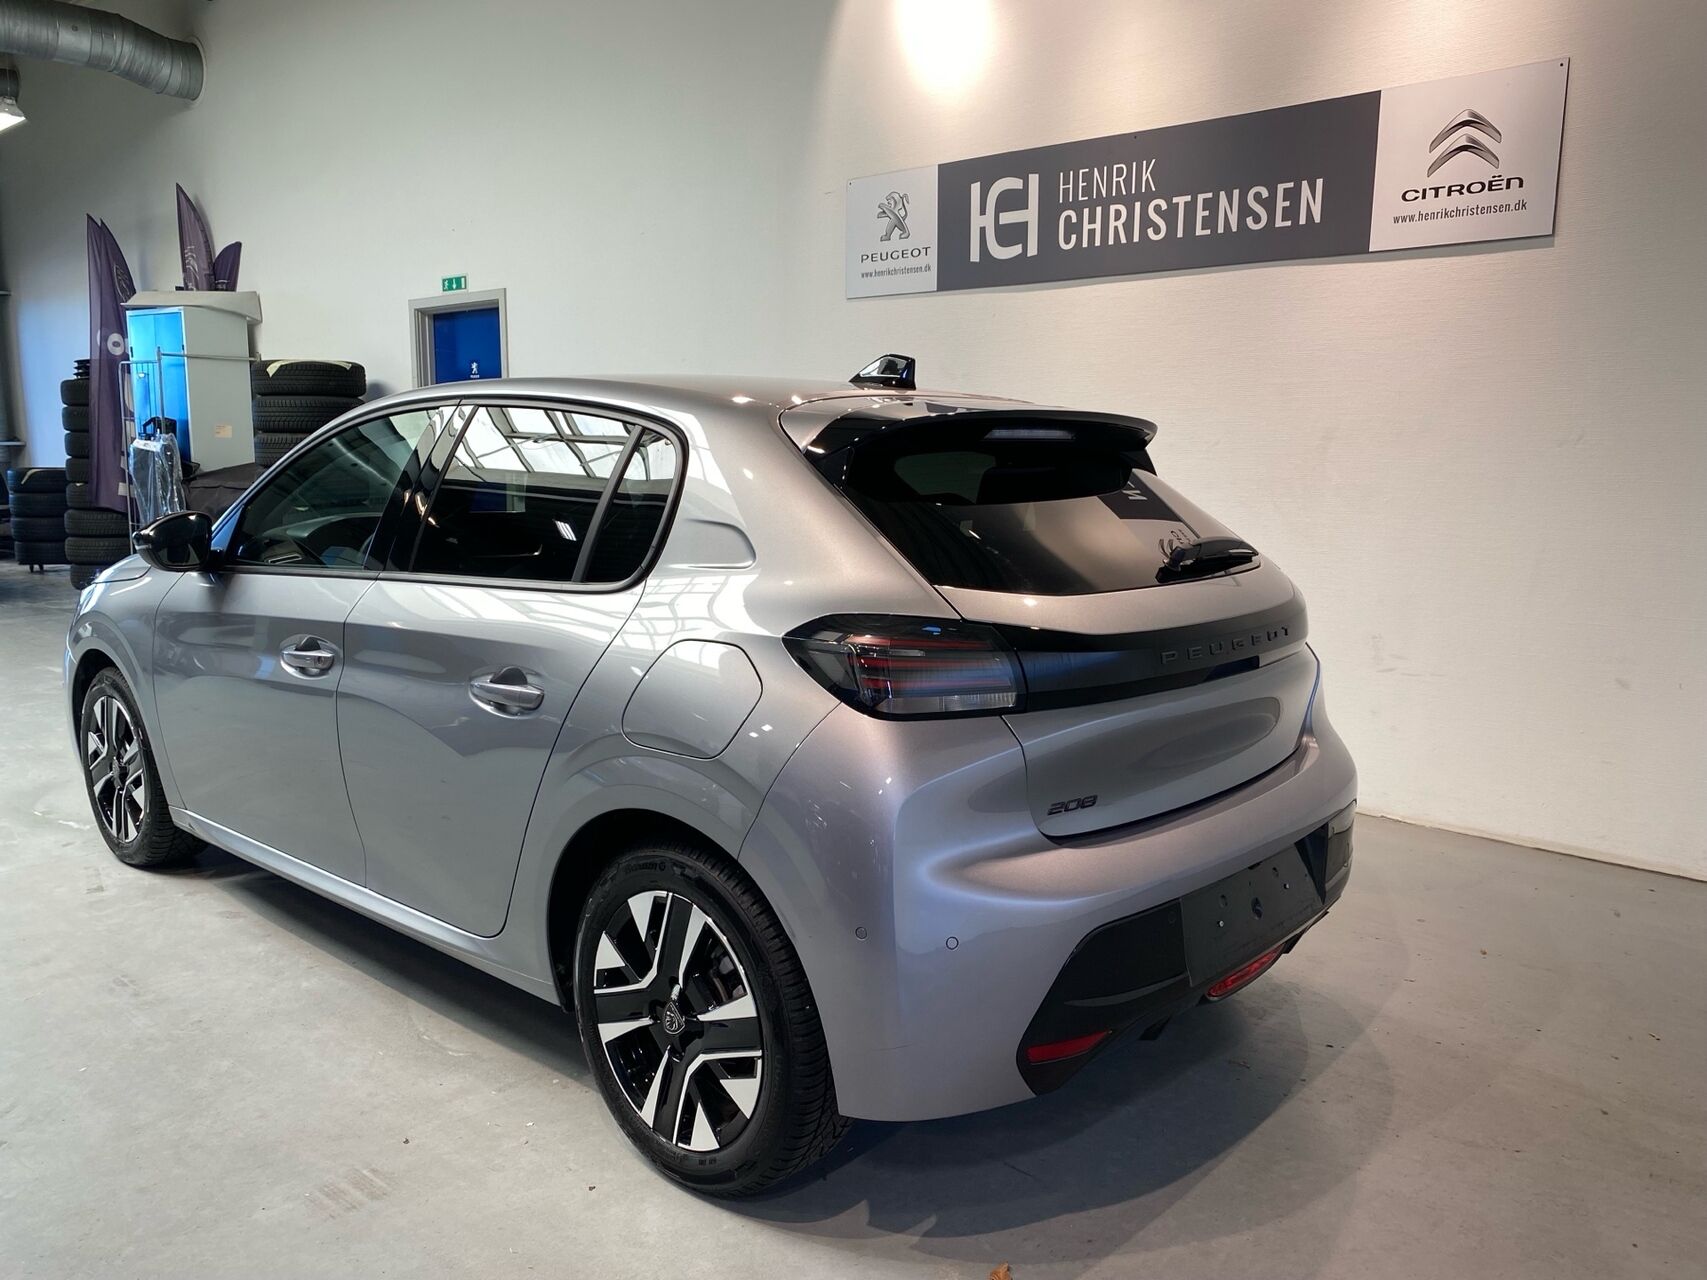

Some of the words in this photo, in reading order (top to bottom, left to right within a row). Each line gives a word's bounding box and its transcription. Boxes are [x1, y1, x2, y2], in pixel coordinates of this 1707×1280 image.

[1059, 158, 1157, 204] HENRIK
[1058, 178, 1324, 250] CHRISTENSEN
[1393, 199, 1528, 225] www.henrikchristensen.dk
[860, 246, 931, 264] PEUGEOT
[860, 264, 932, 279] www.henrikchristensen.dk
[1160, 626, 1289, 665] PEUGEOT
[1047, 794, 1098, 816] 208
